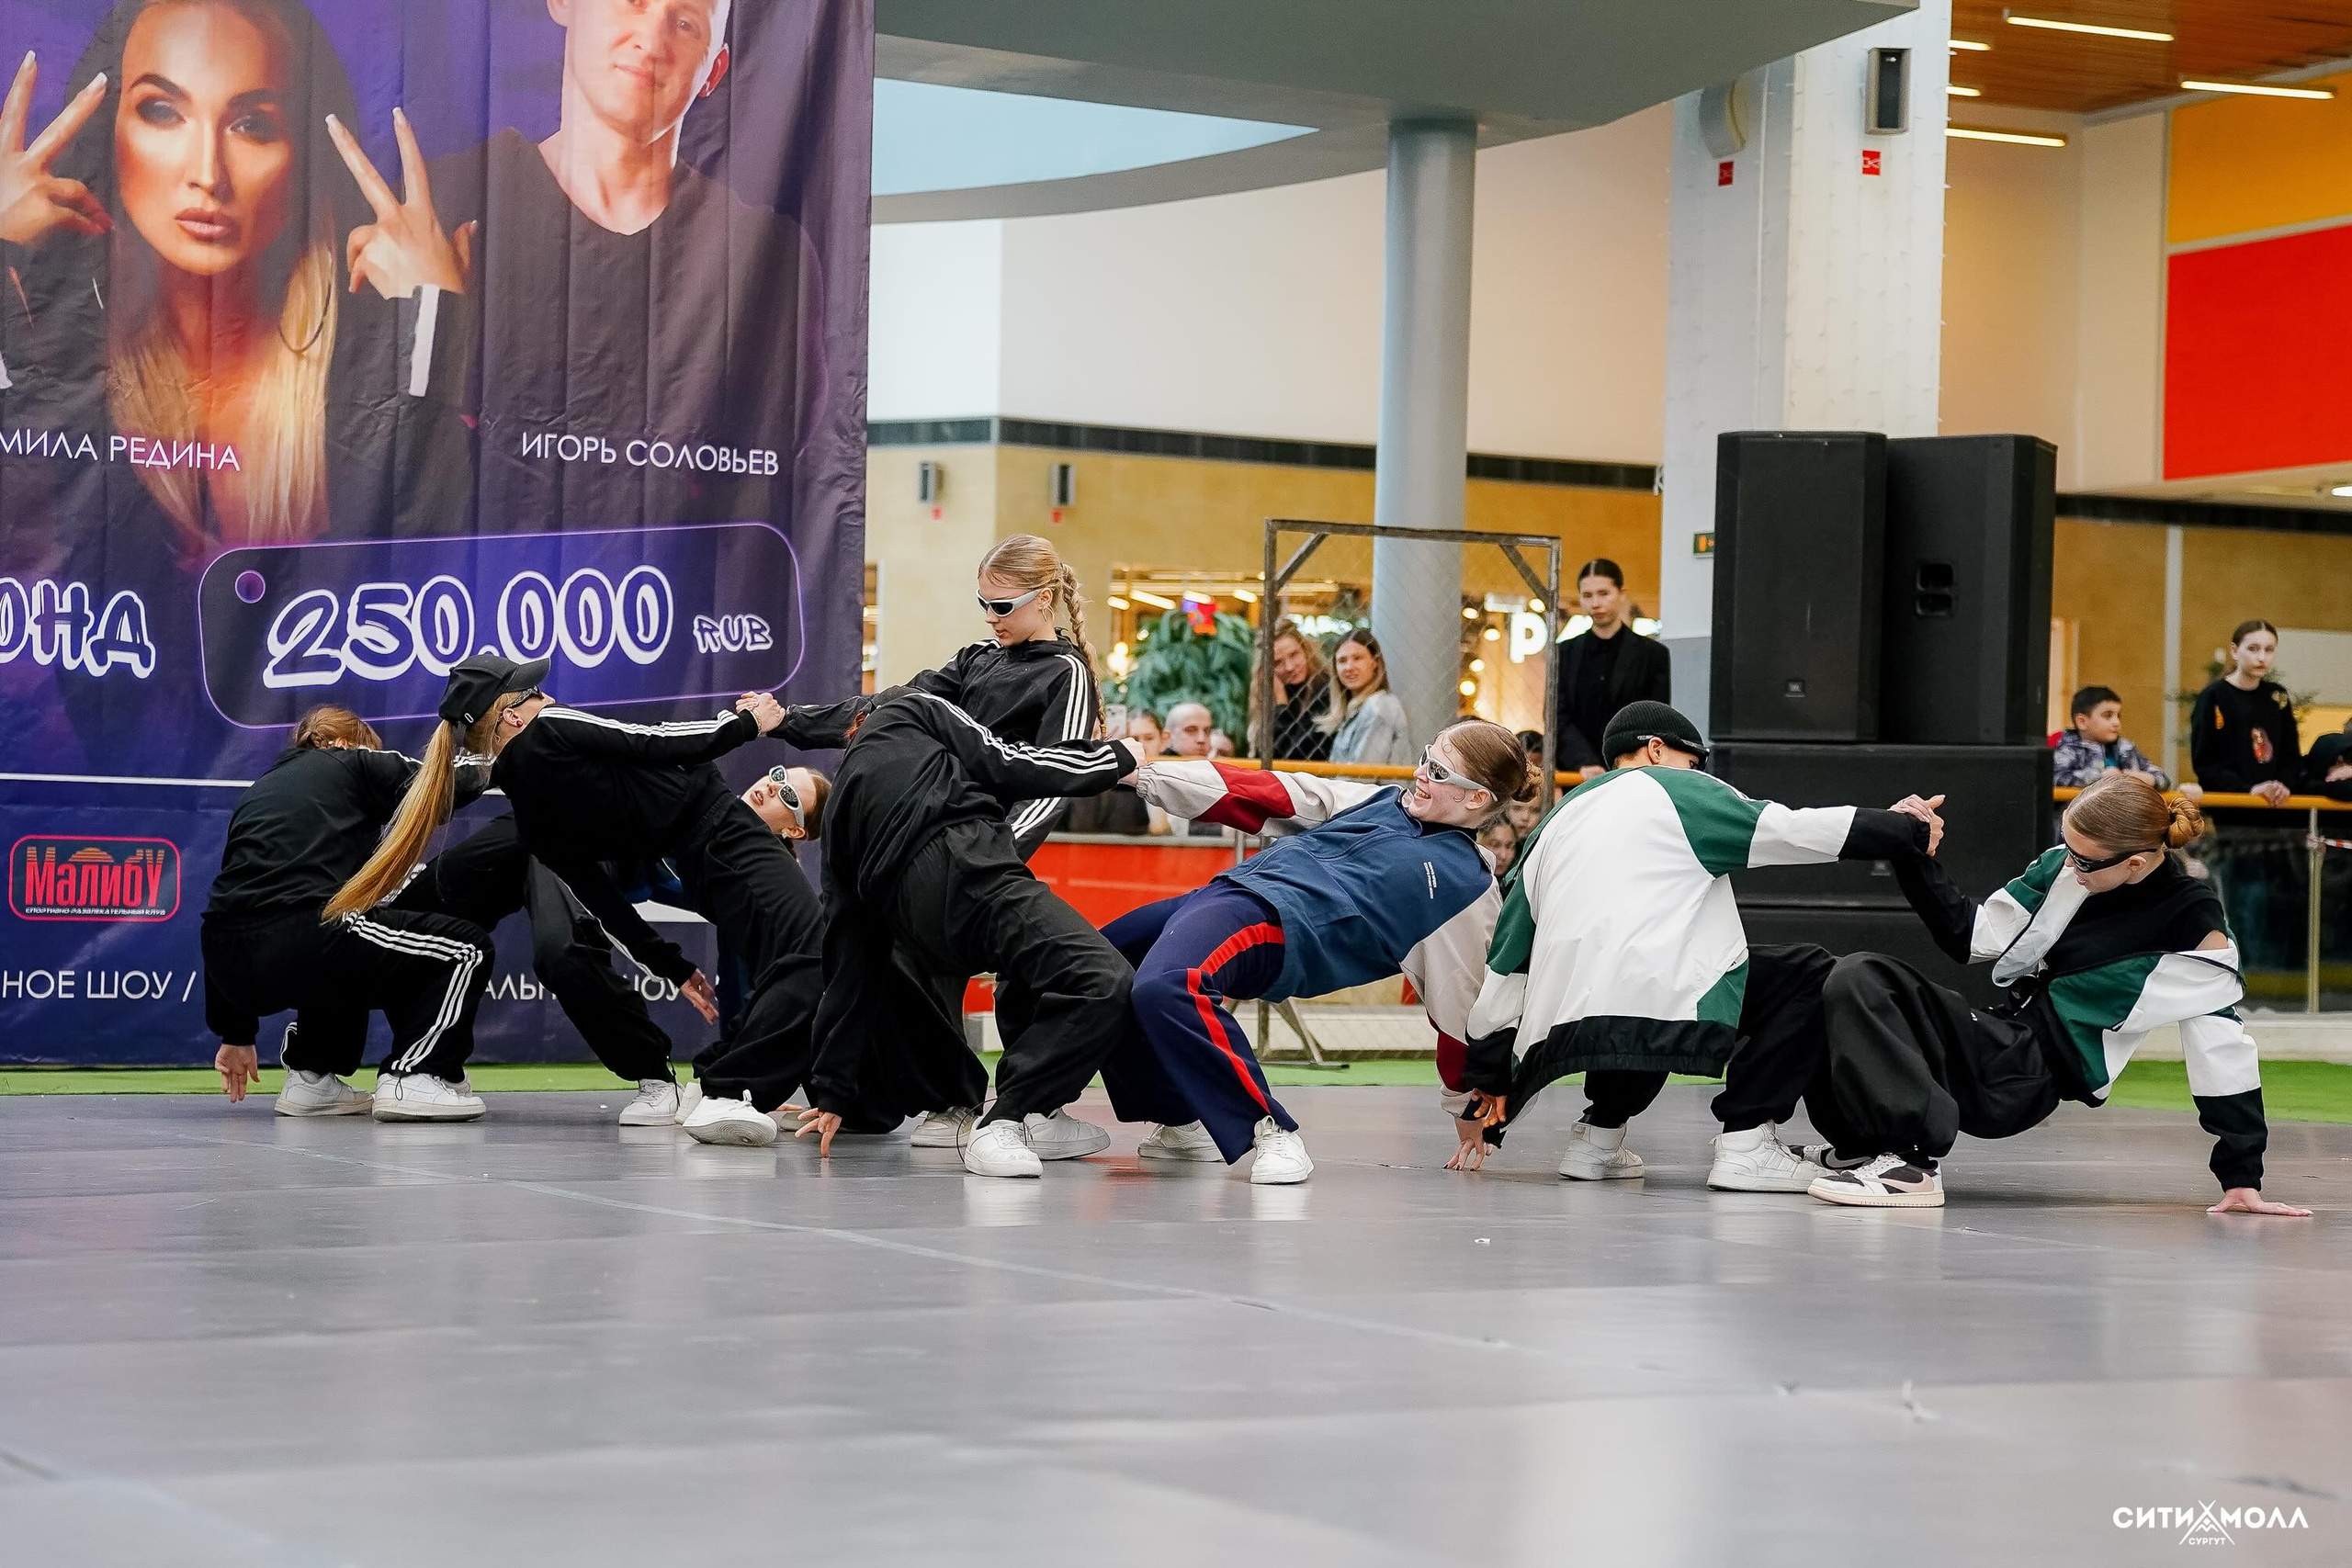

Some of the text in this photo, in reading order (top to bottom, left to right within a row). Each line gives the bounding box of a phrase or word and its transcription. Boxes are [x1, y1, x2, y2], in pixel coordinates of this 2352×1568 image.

[0, 428, 241, 472] МИЛА РЕДИНА
[521, 431, 780, 477] ИГОРЬ СОЛОВЬЕВ
[693, 614, 774, 654] RUB
[2, 970, 75, 999] НОЕ
[86, 970, 173, 1000] ШОУ
